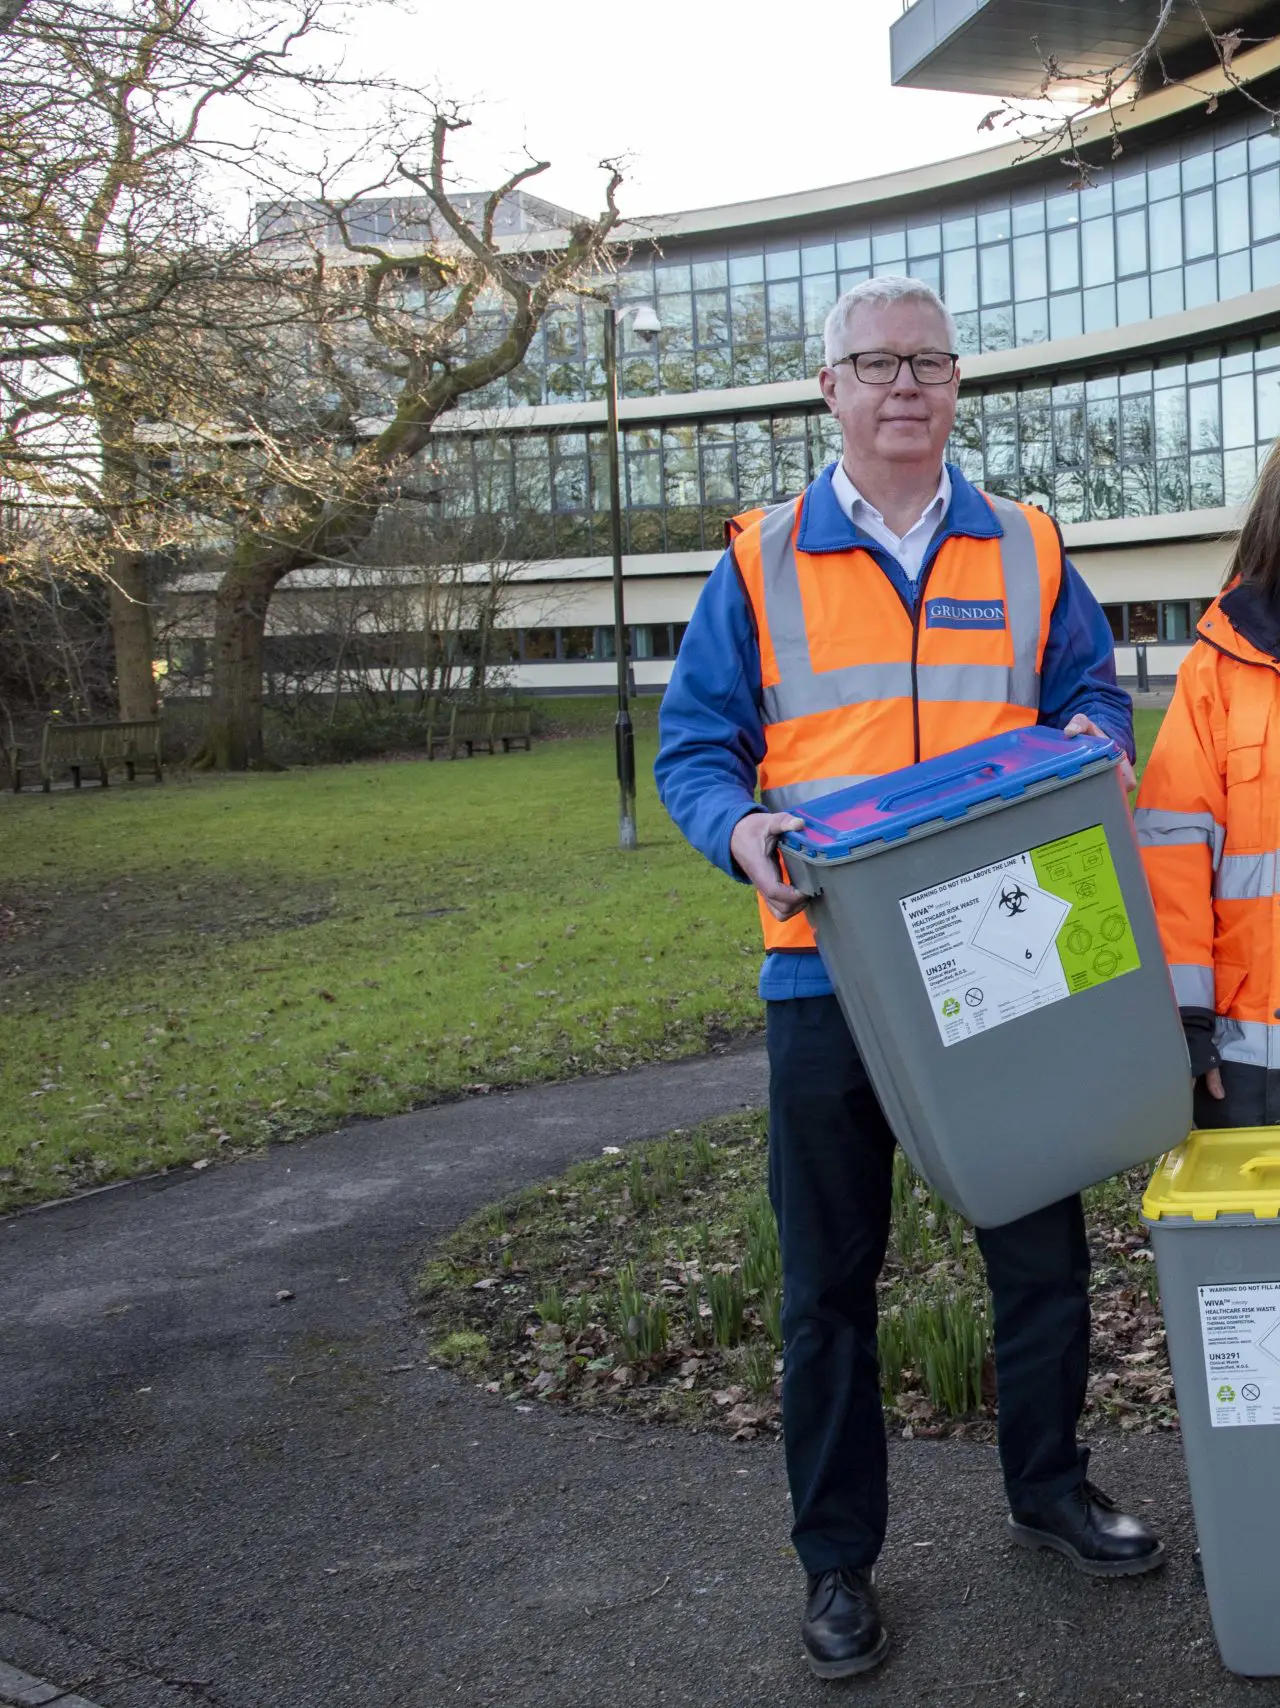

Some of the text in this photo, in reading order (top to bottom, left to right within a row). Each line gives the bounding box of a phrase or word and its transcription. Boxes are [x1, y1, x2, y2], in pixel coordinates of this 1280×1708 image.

[931, 605, 1005, 619] GRUNDON
[910, 889, 938, 903] WARNING
[938, 885, 947, 893] DO
[948, 880, 959, 889] NOT
[960, 876, 972, 884] FILL
[973, 869, 991, 879] ABOVE
[1004, 859, 1016, 867] LINE
[912, 898, 980, 928] HEALTHCARE RISK WASTE
[1025, 949, 1032, 960] 6
[926, 959, 956, 976] UN3291
[1209, 1352, 1240, 1360] UN3291
